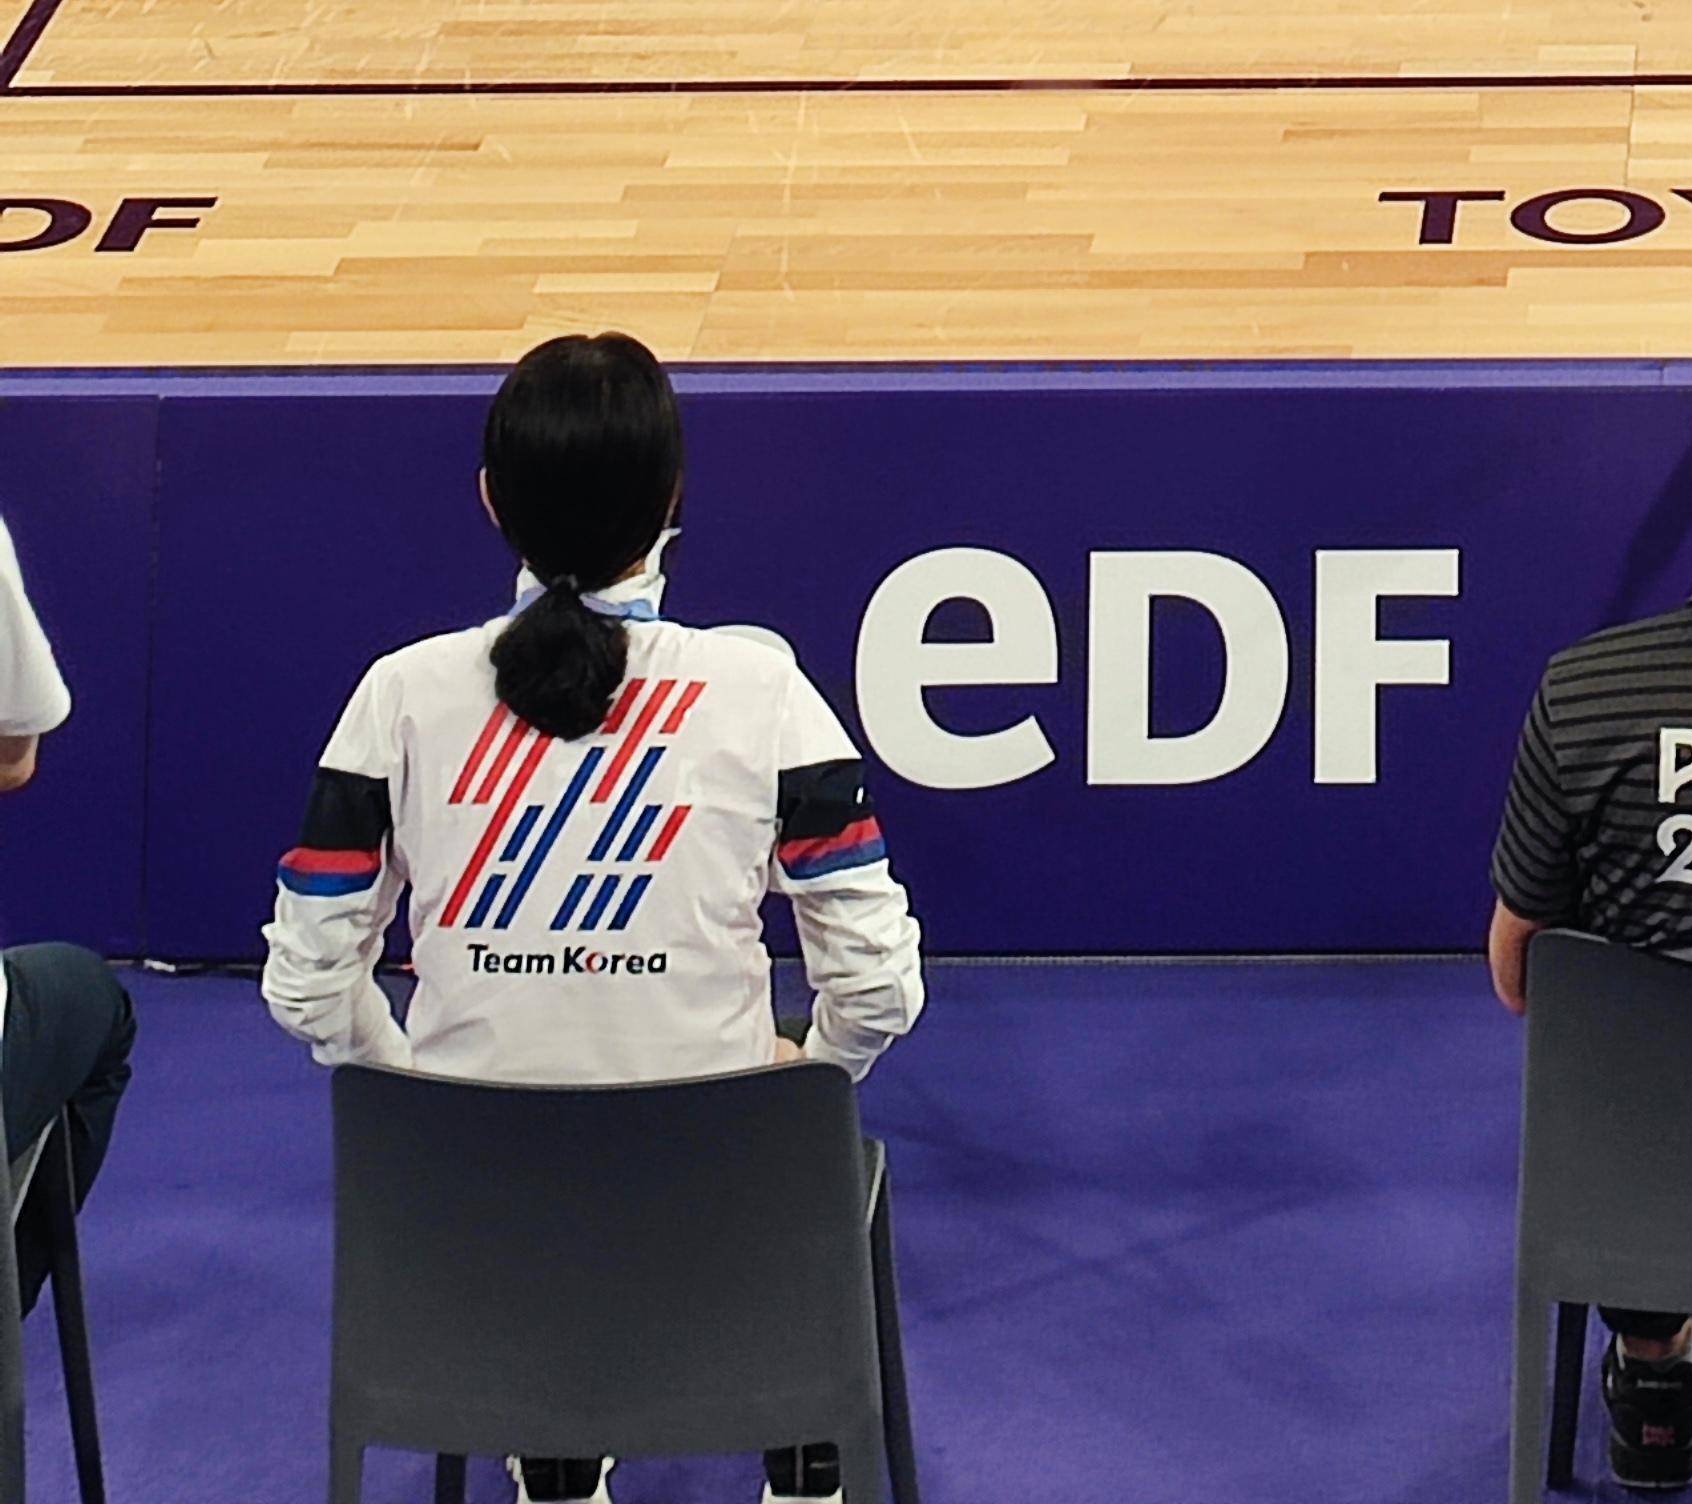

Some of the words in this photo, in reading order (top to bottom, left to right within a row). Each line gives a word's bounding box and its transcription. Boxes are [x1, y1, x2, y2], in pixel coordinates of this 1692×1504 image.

[0, 196, 218, 254] DF
[855, 546, 1459, 789] eDF
[467, 943, 555, 975] Team
[562, 943, 668, 976] Korea
